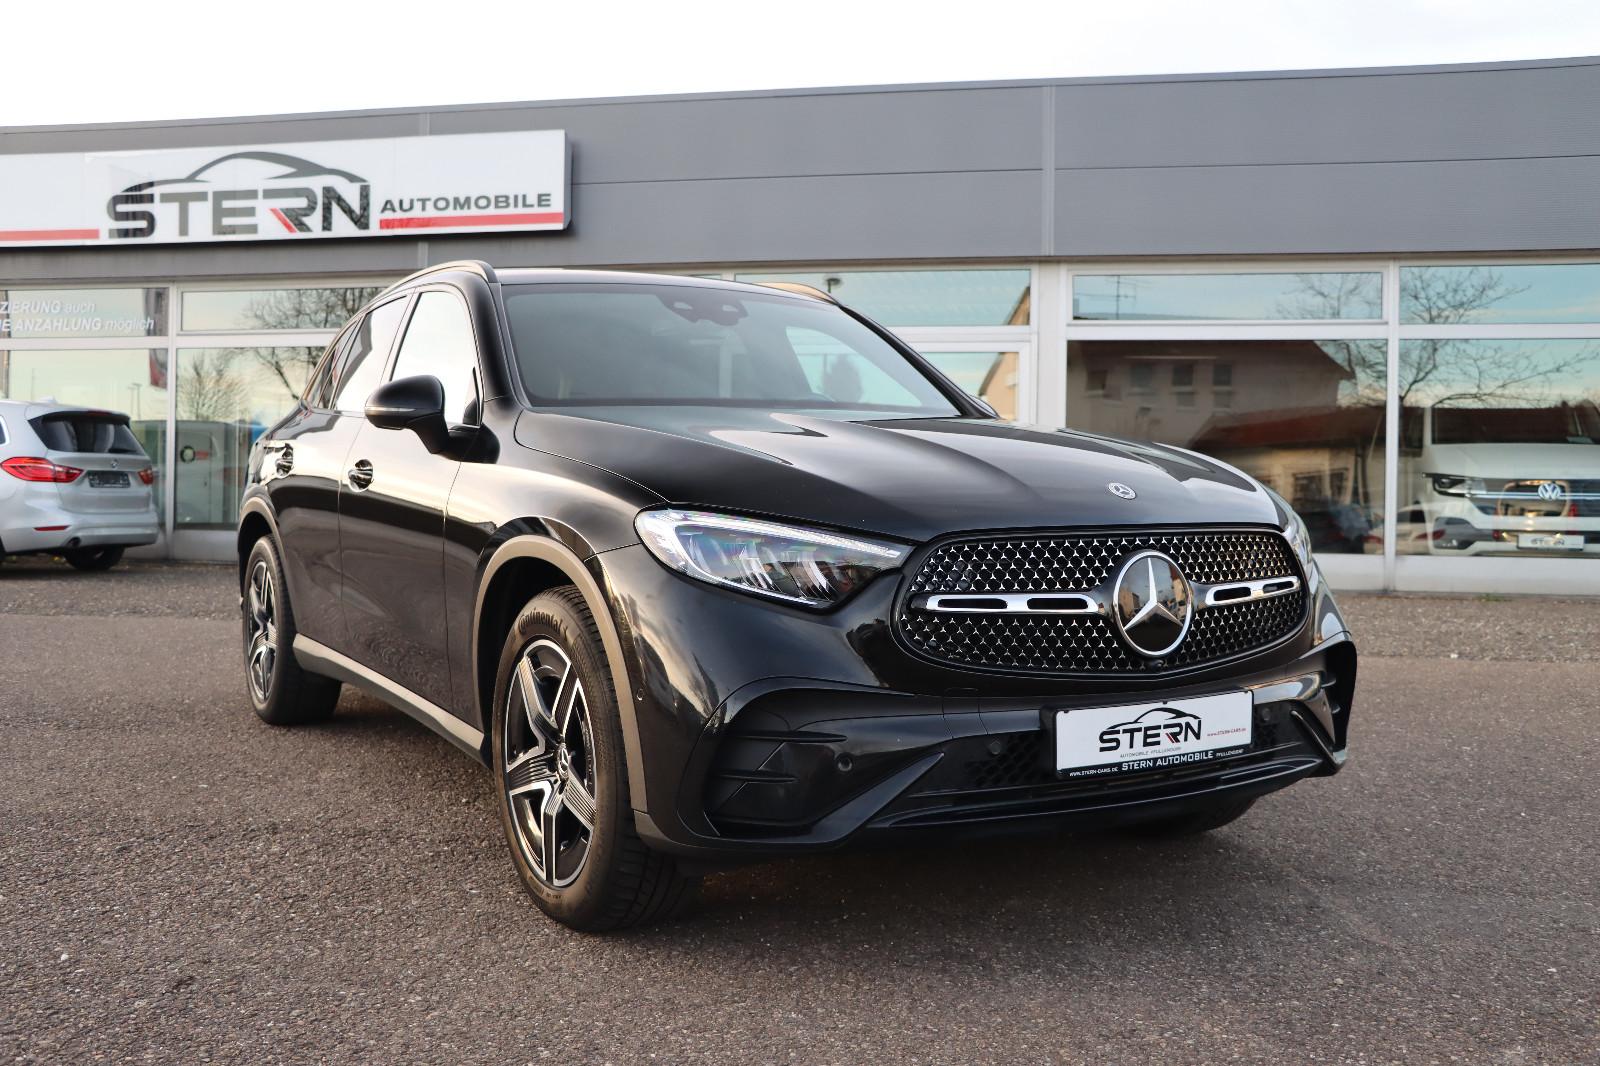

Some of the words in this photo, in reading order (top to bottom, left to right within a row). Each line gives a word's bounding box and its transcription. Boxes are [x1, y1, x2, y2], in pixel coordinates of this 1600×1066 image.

[106, 184, 371, 240] STERN
[380, 192, 552, 214] AUTOMOBILE
[64, 302, 95, 313] auch
[16, 317, 101, 331] ANZAHLUNG
[518, 607, 563, 635] Continental
[1099, 720, 1202, 752] STERN
[1121, 759, 1153, 771] STERN
[1156, 751, 1214, 766] AUTOMOBILE
